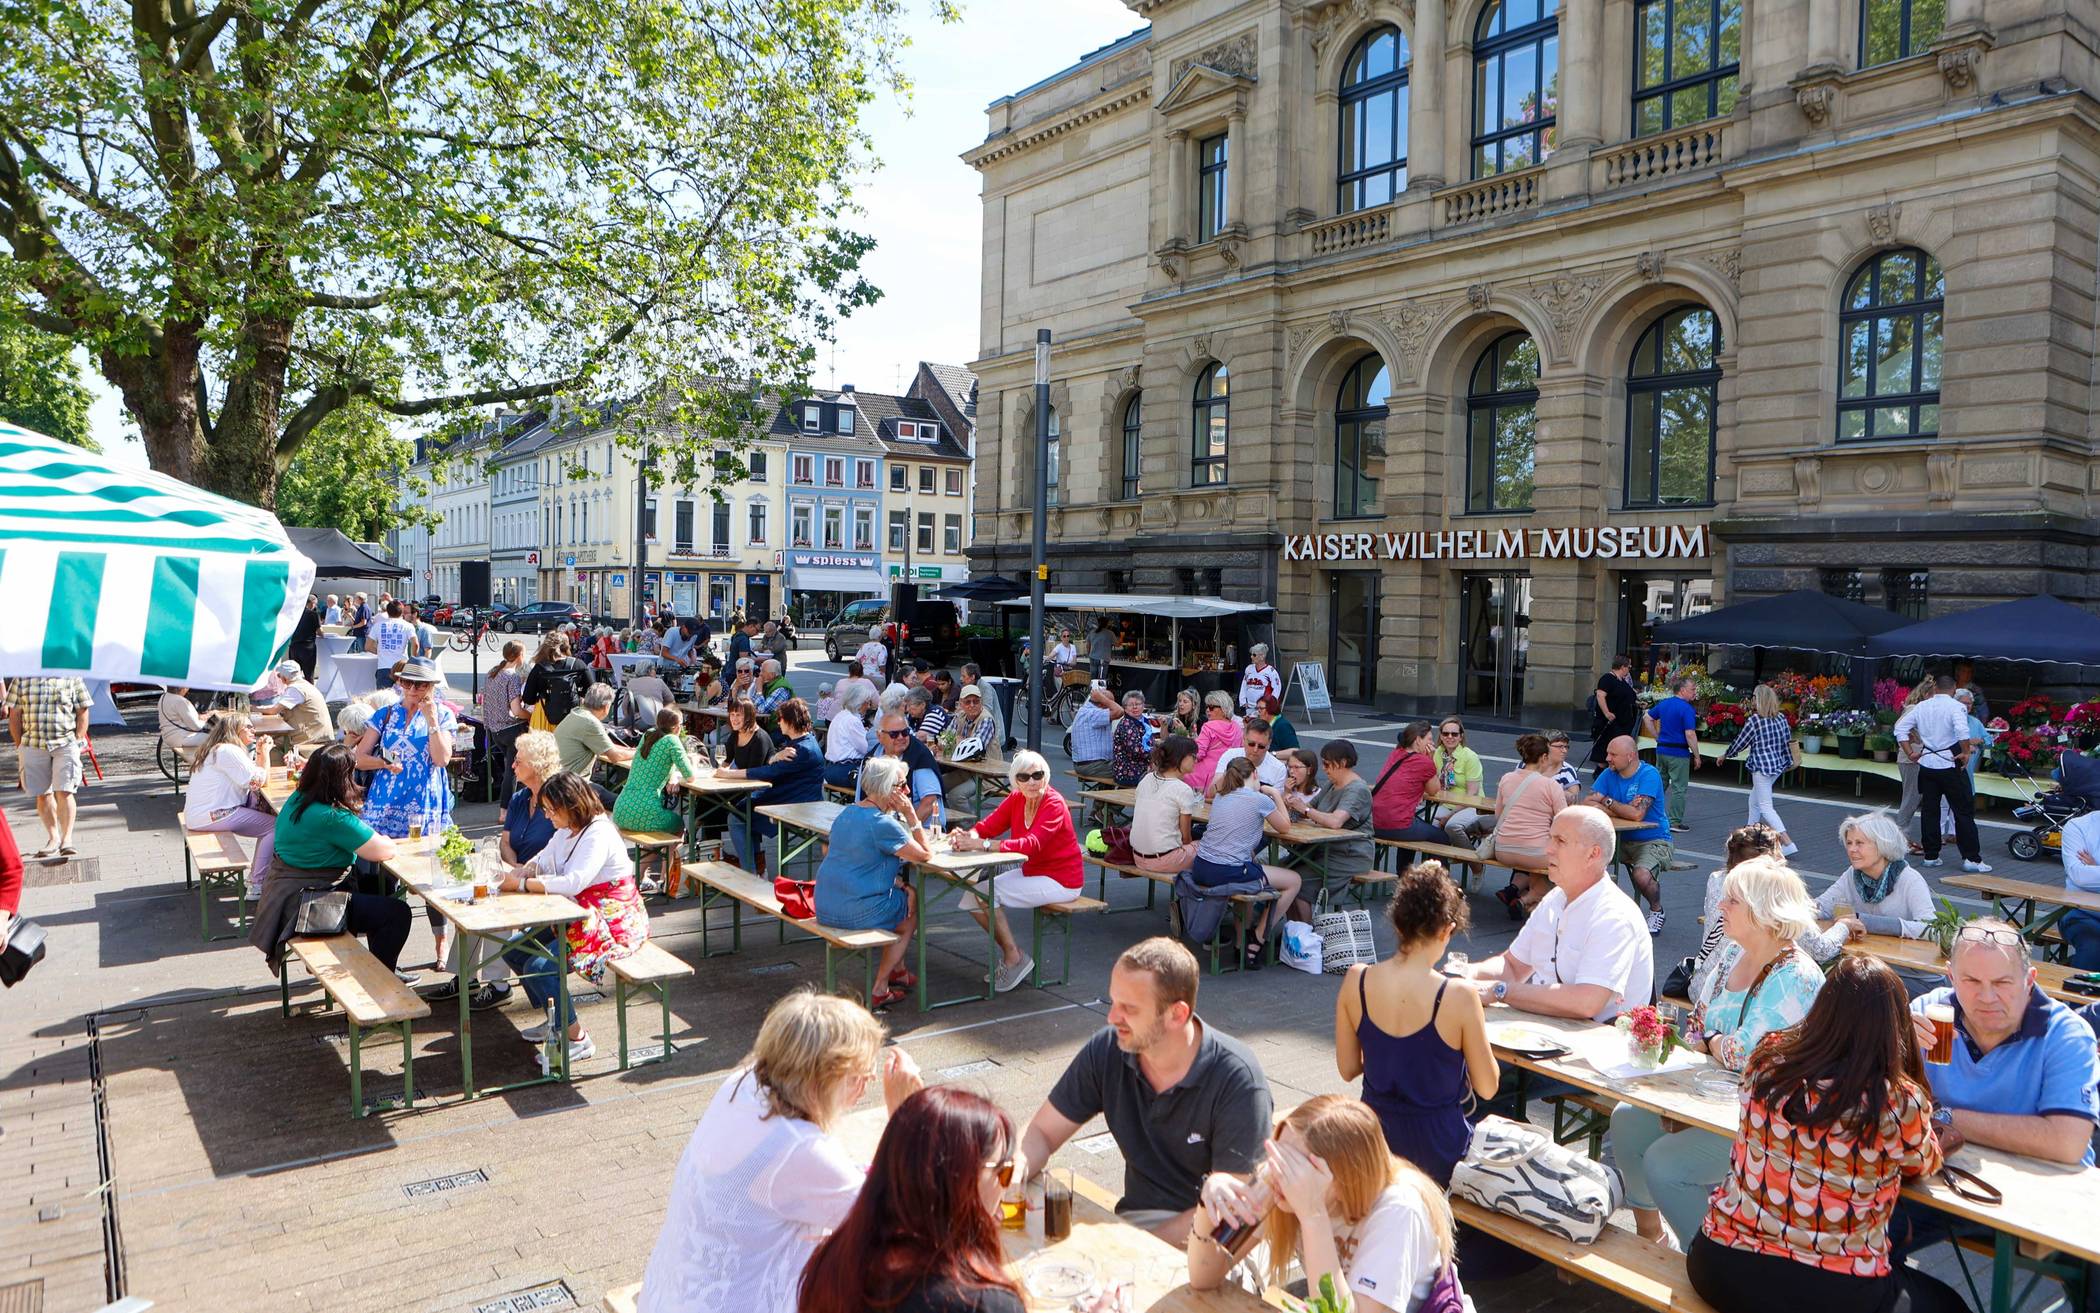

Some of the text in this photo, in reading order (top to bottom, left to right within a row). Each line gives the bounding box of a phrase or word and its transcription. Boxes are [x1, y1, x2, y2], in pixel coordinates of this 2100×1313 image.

[1284, 525, 1706, 560] KAISER WILHELM MUSEUM
[812, 555, 857, 567] spiess
